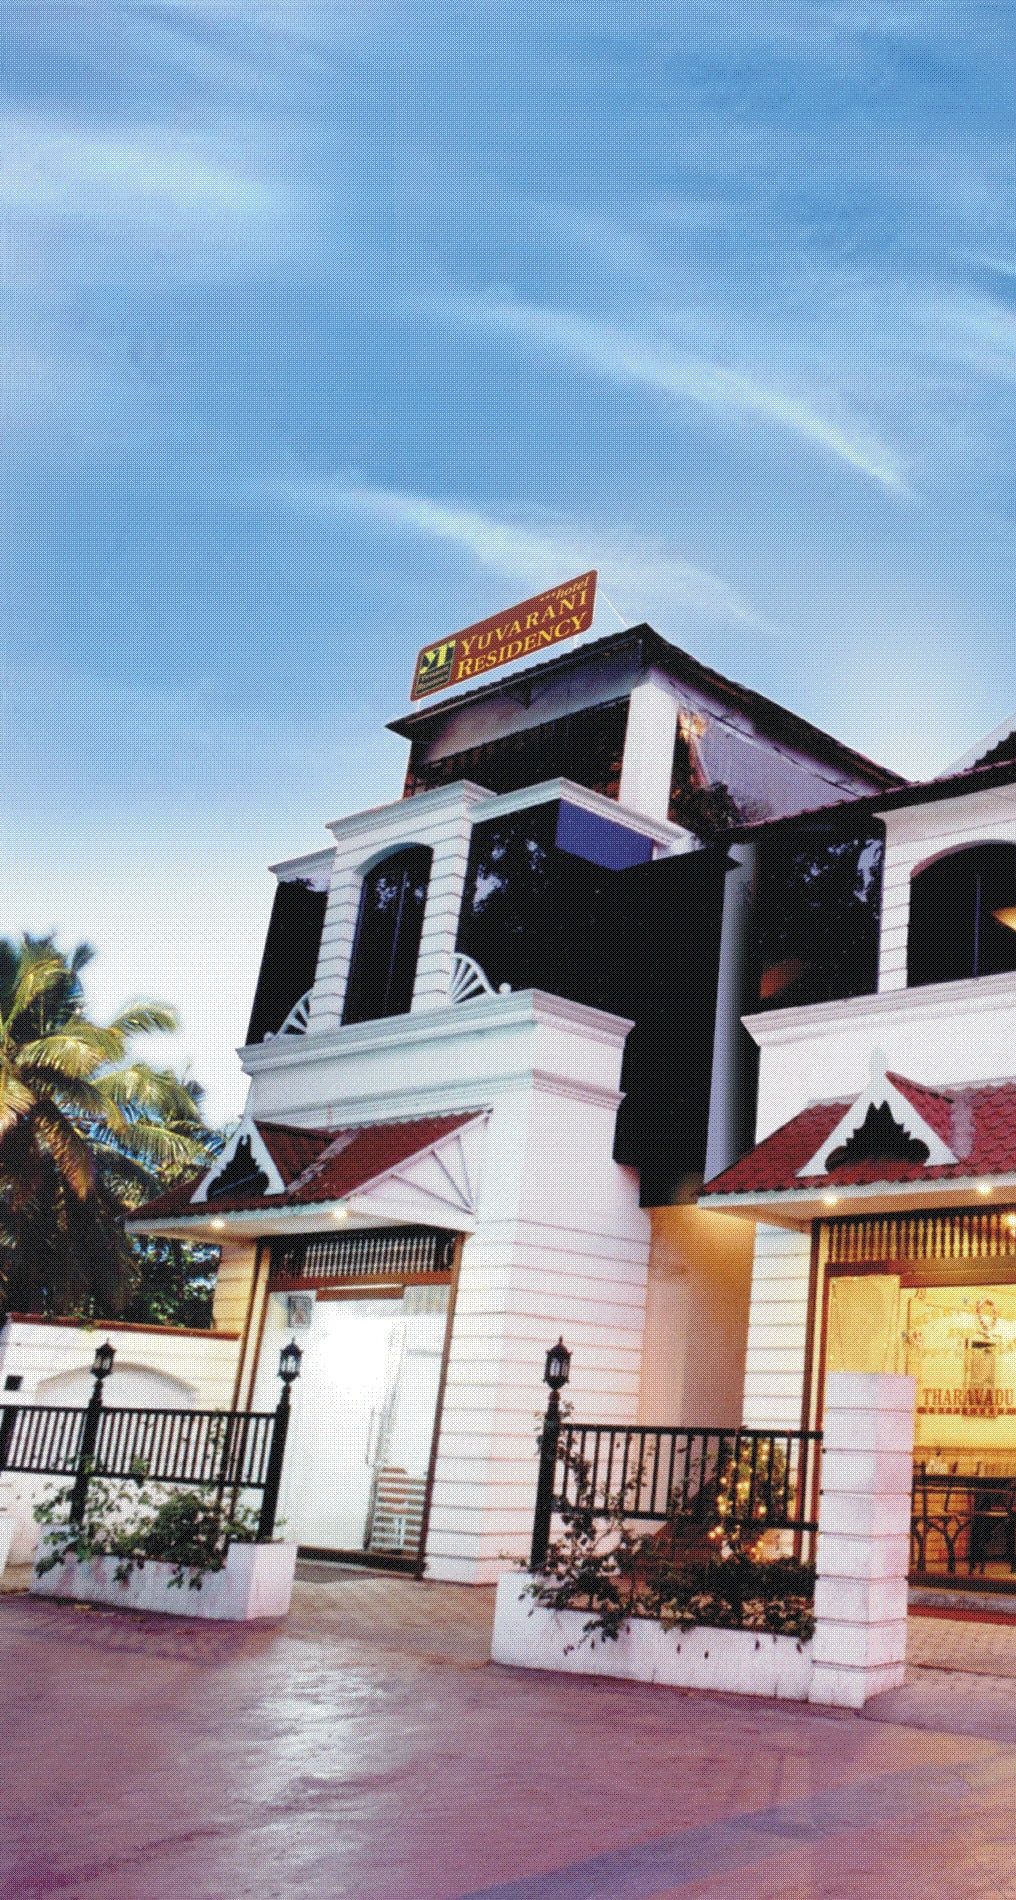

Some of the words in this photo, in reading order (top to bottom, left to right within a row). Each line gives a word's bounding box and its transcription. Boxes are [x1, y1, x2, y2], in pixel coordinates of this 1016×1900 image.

[456, 611, 588, 681] RESIDENCY
[458, 588, 589, 657] YUVARANI
[922, 1387, 1014, 1406] THARAVADU
